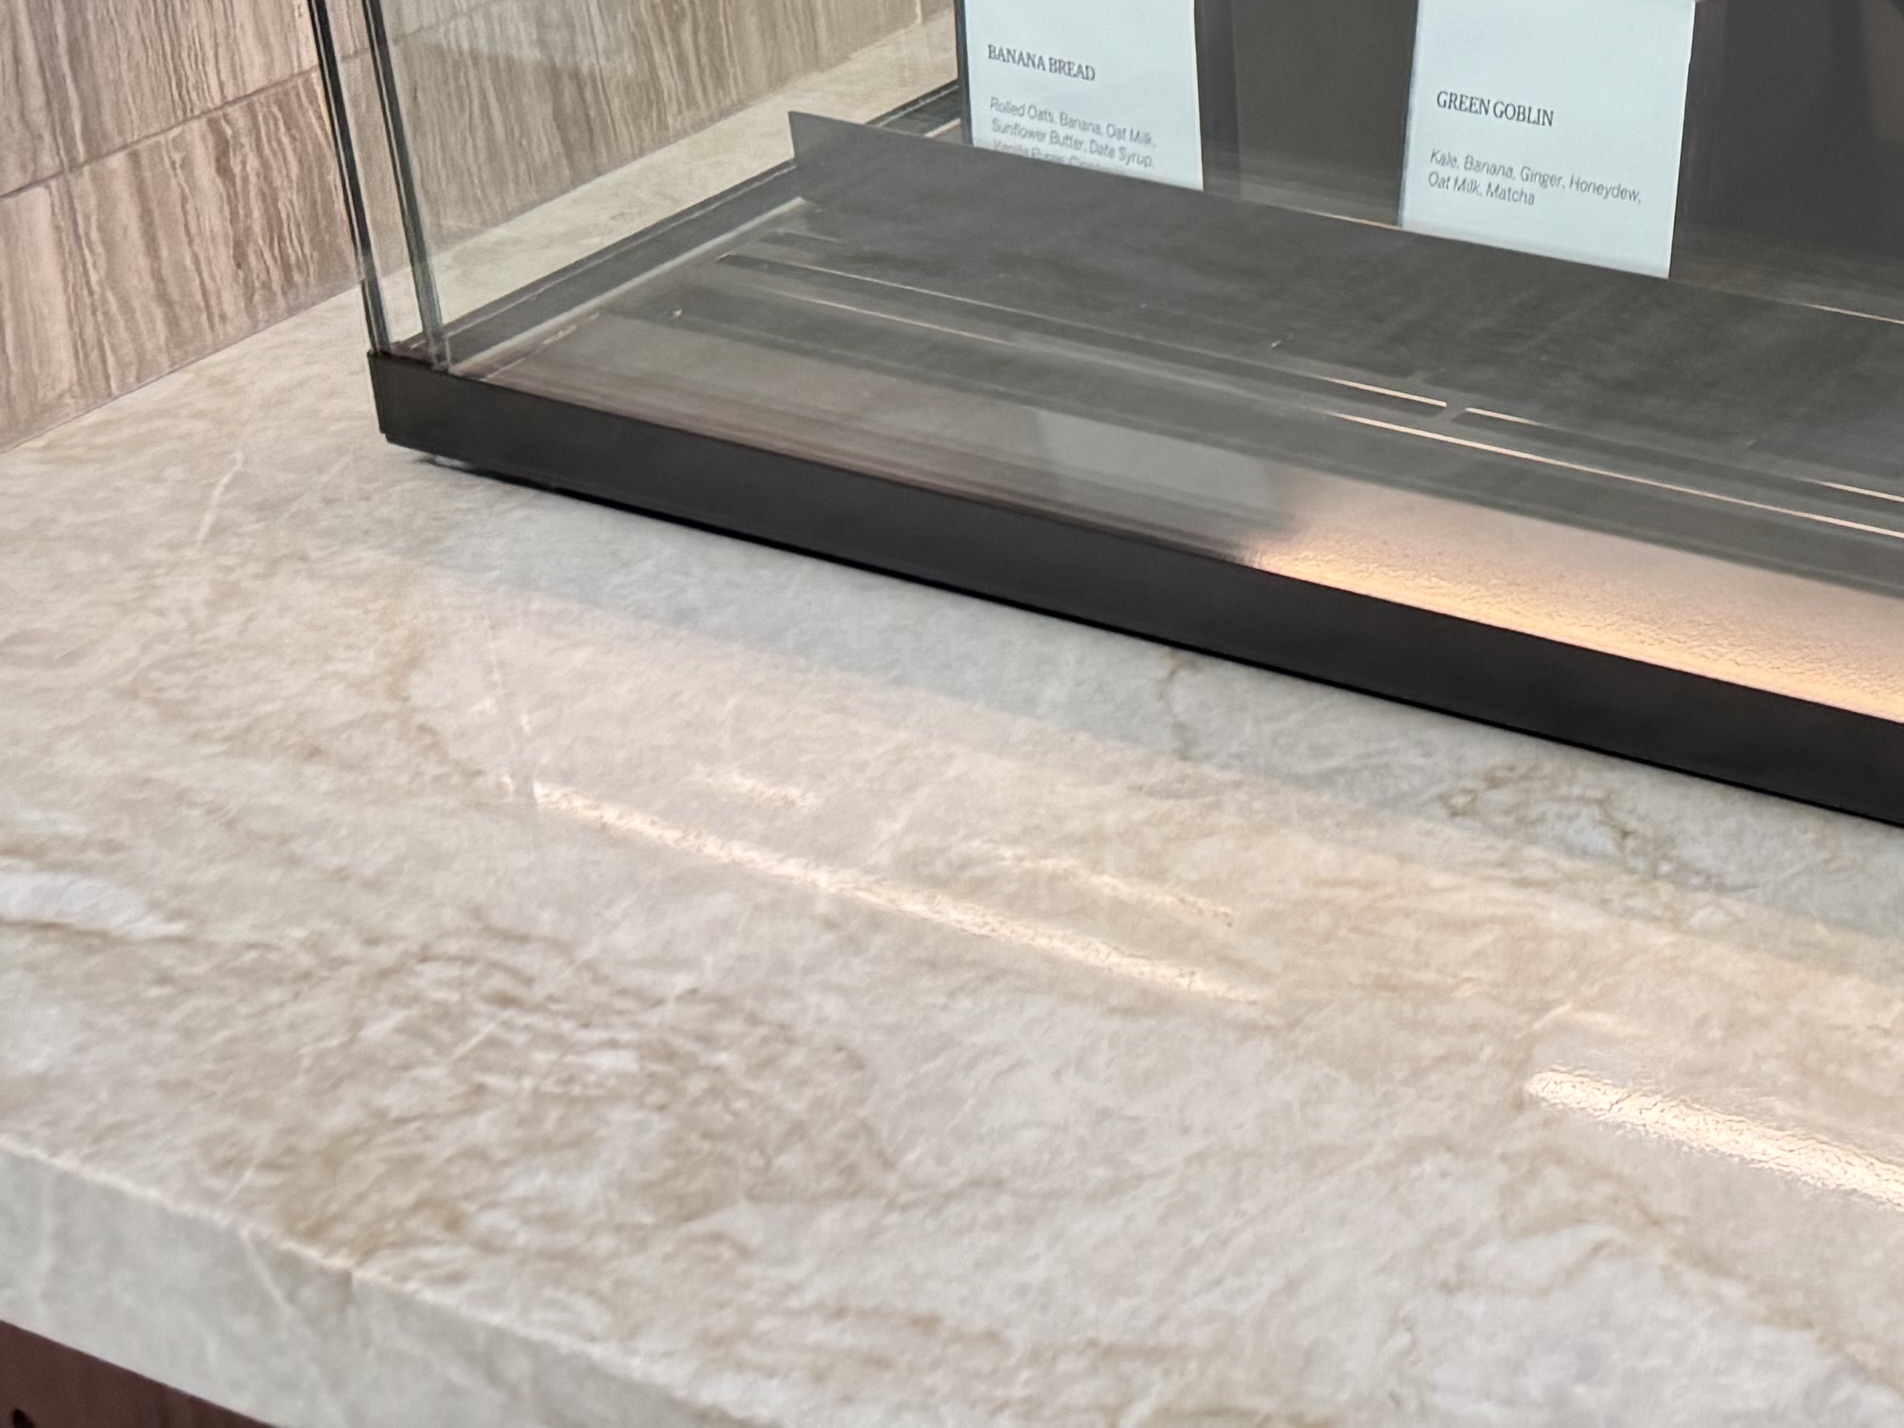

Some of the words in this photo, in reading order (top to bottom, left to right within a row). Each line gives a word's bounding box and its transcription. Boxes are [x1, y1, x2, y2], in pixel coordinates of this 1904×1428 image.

[988, 44, 1046, 72] BANANA
[1049, 58, 1095, 81] BREAD
[1437, 91, 1490, 115] GREEN
[1493, 101, 1554, 127] GOBLIN
[1106, 124, 1128, 140] Oat
[1428, 172, 1450, 188] Oat
[1486, 181, 1534, 205] Matcha
[1570, 174, 1640, 204] Honeydew,
